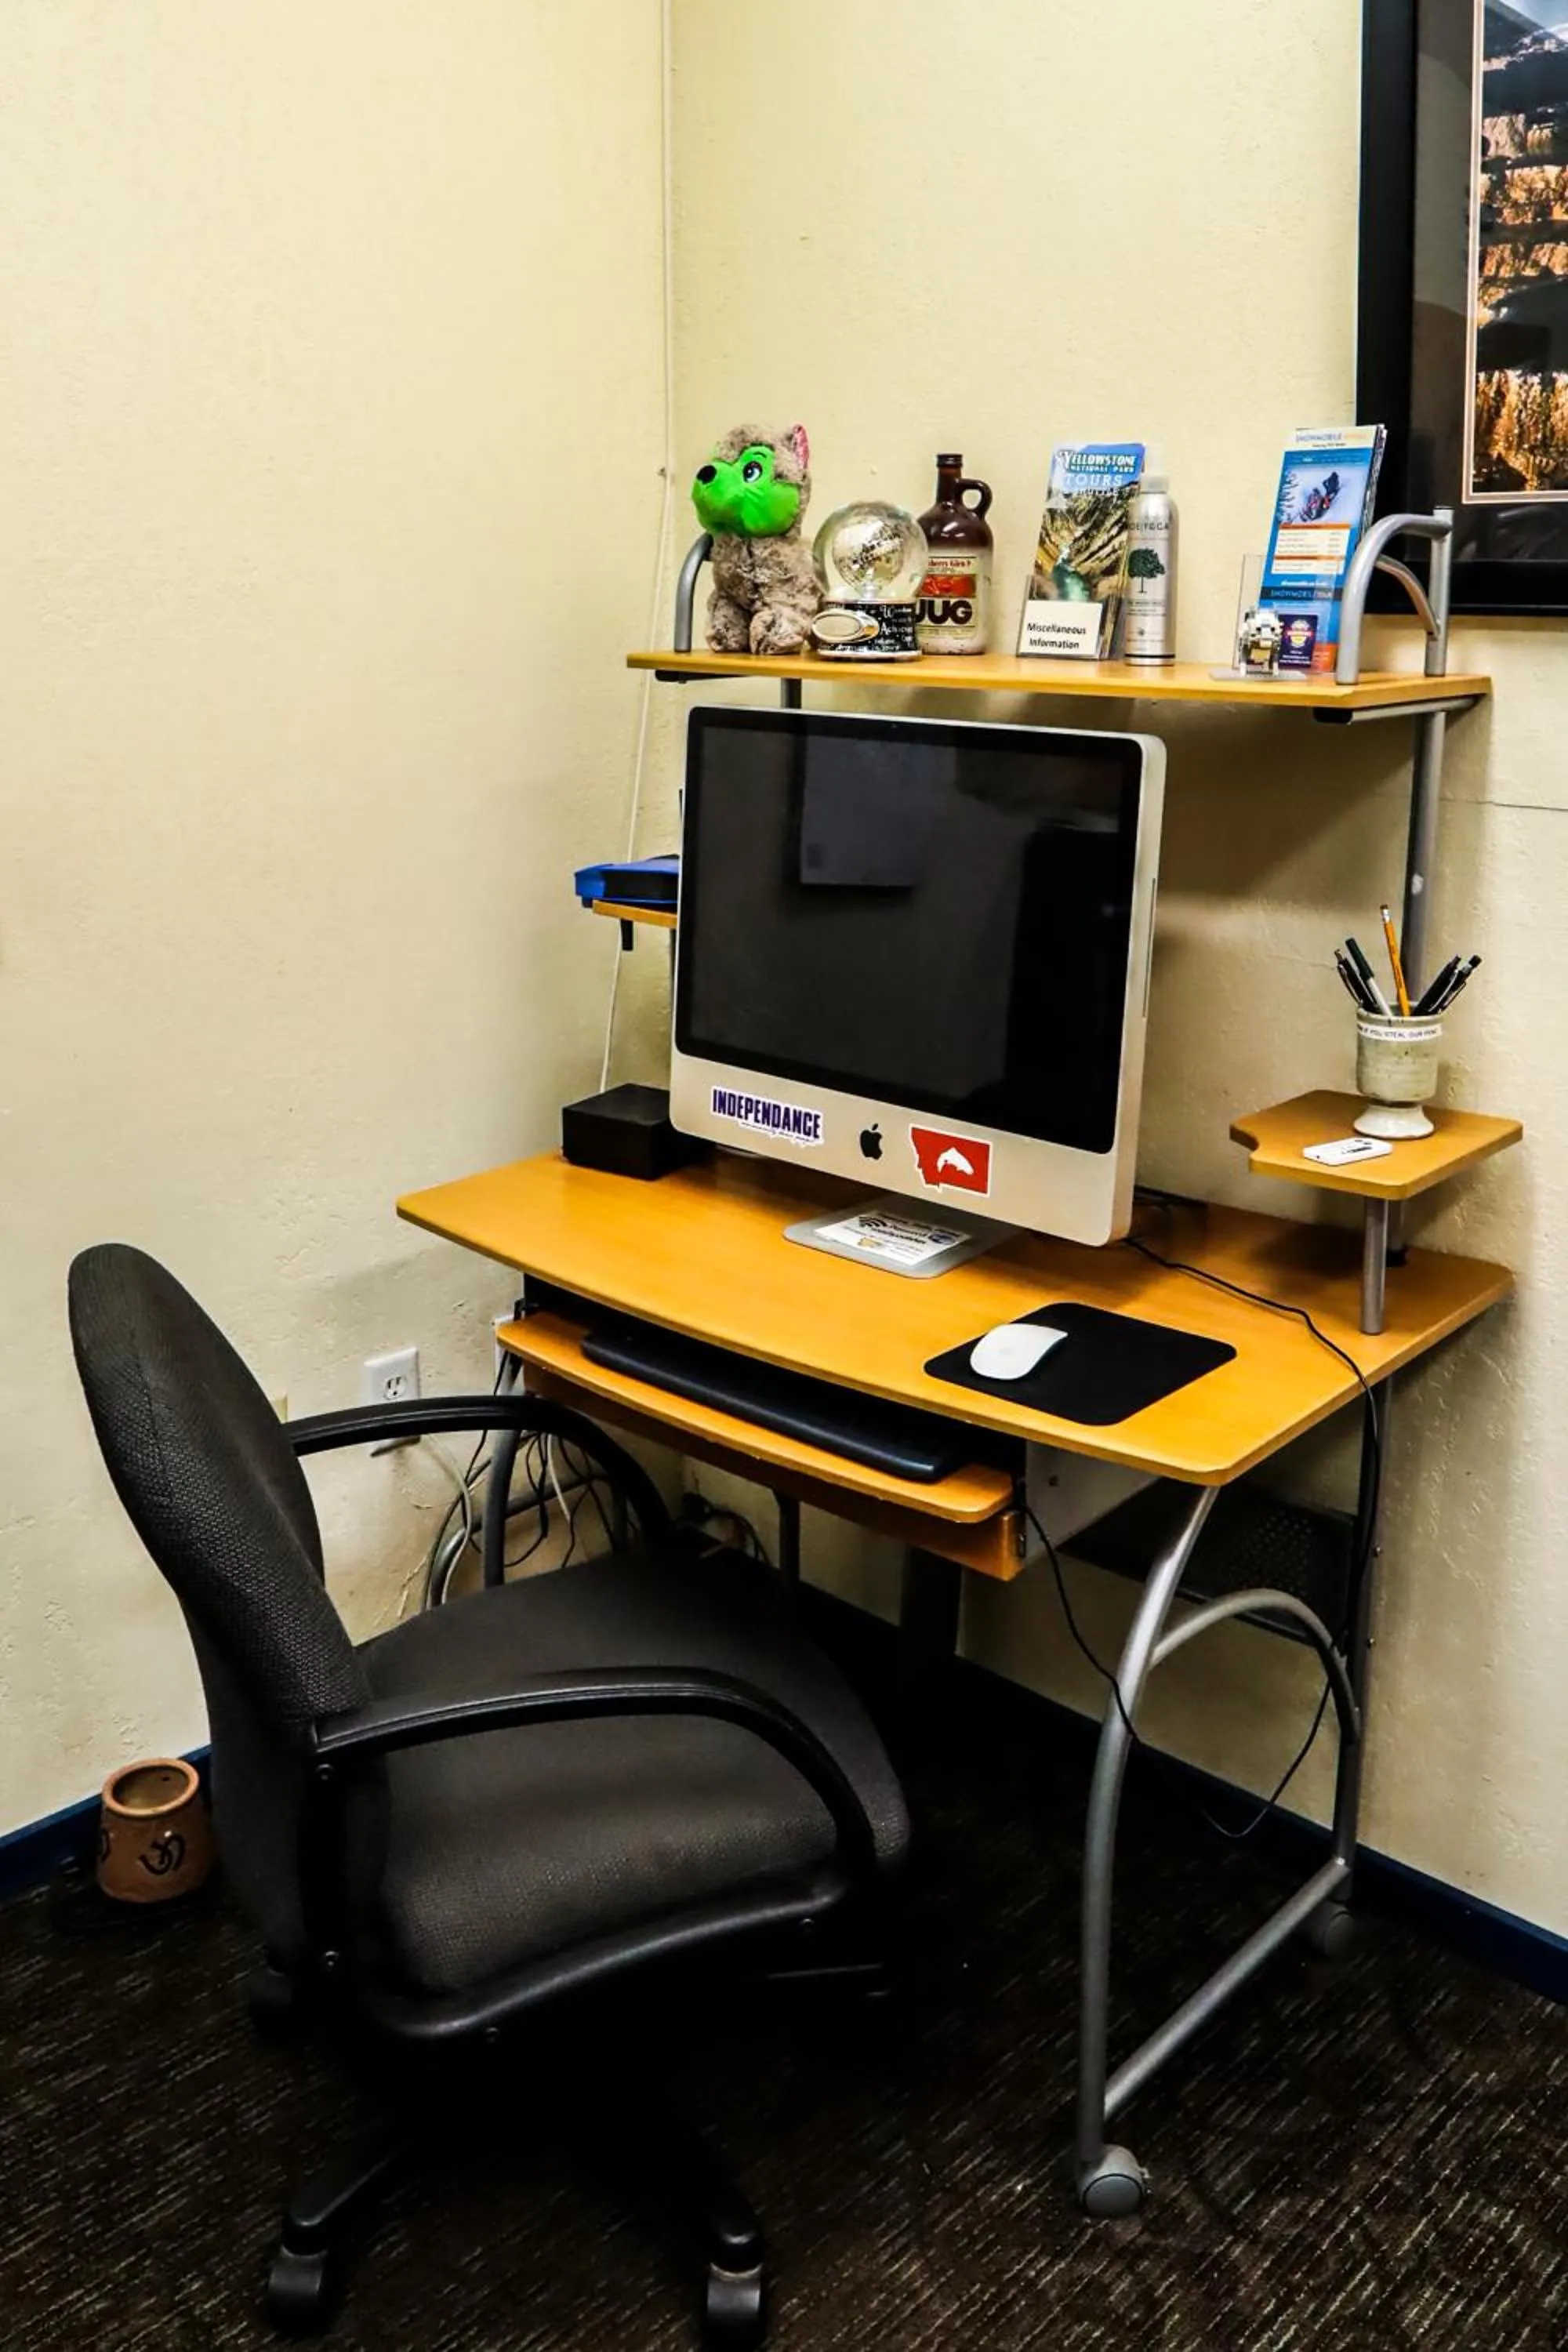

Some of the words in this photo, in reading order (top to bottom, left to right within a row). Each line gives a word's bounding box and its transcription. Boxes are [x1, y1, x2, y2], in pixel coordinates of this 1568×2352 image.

[1059, 451, 1136, 469] YELLOWSTONE
[1065, 473, 1123, 487] TOURS
[916, 599, 972, 625] JUG
[1027, 622, 1086, 633] Miscellaneous
[1029, 637, 1080, 648] Information
[713, 1089, 820, 1138] INDEPENDANCE
